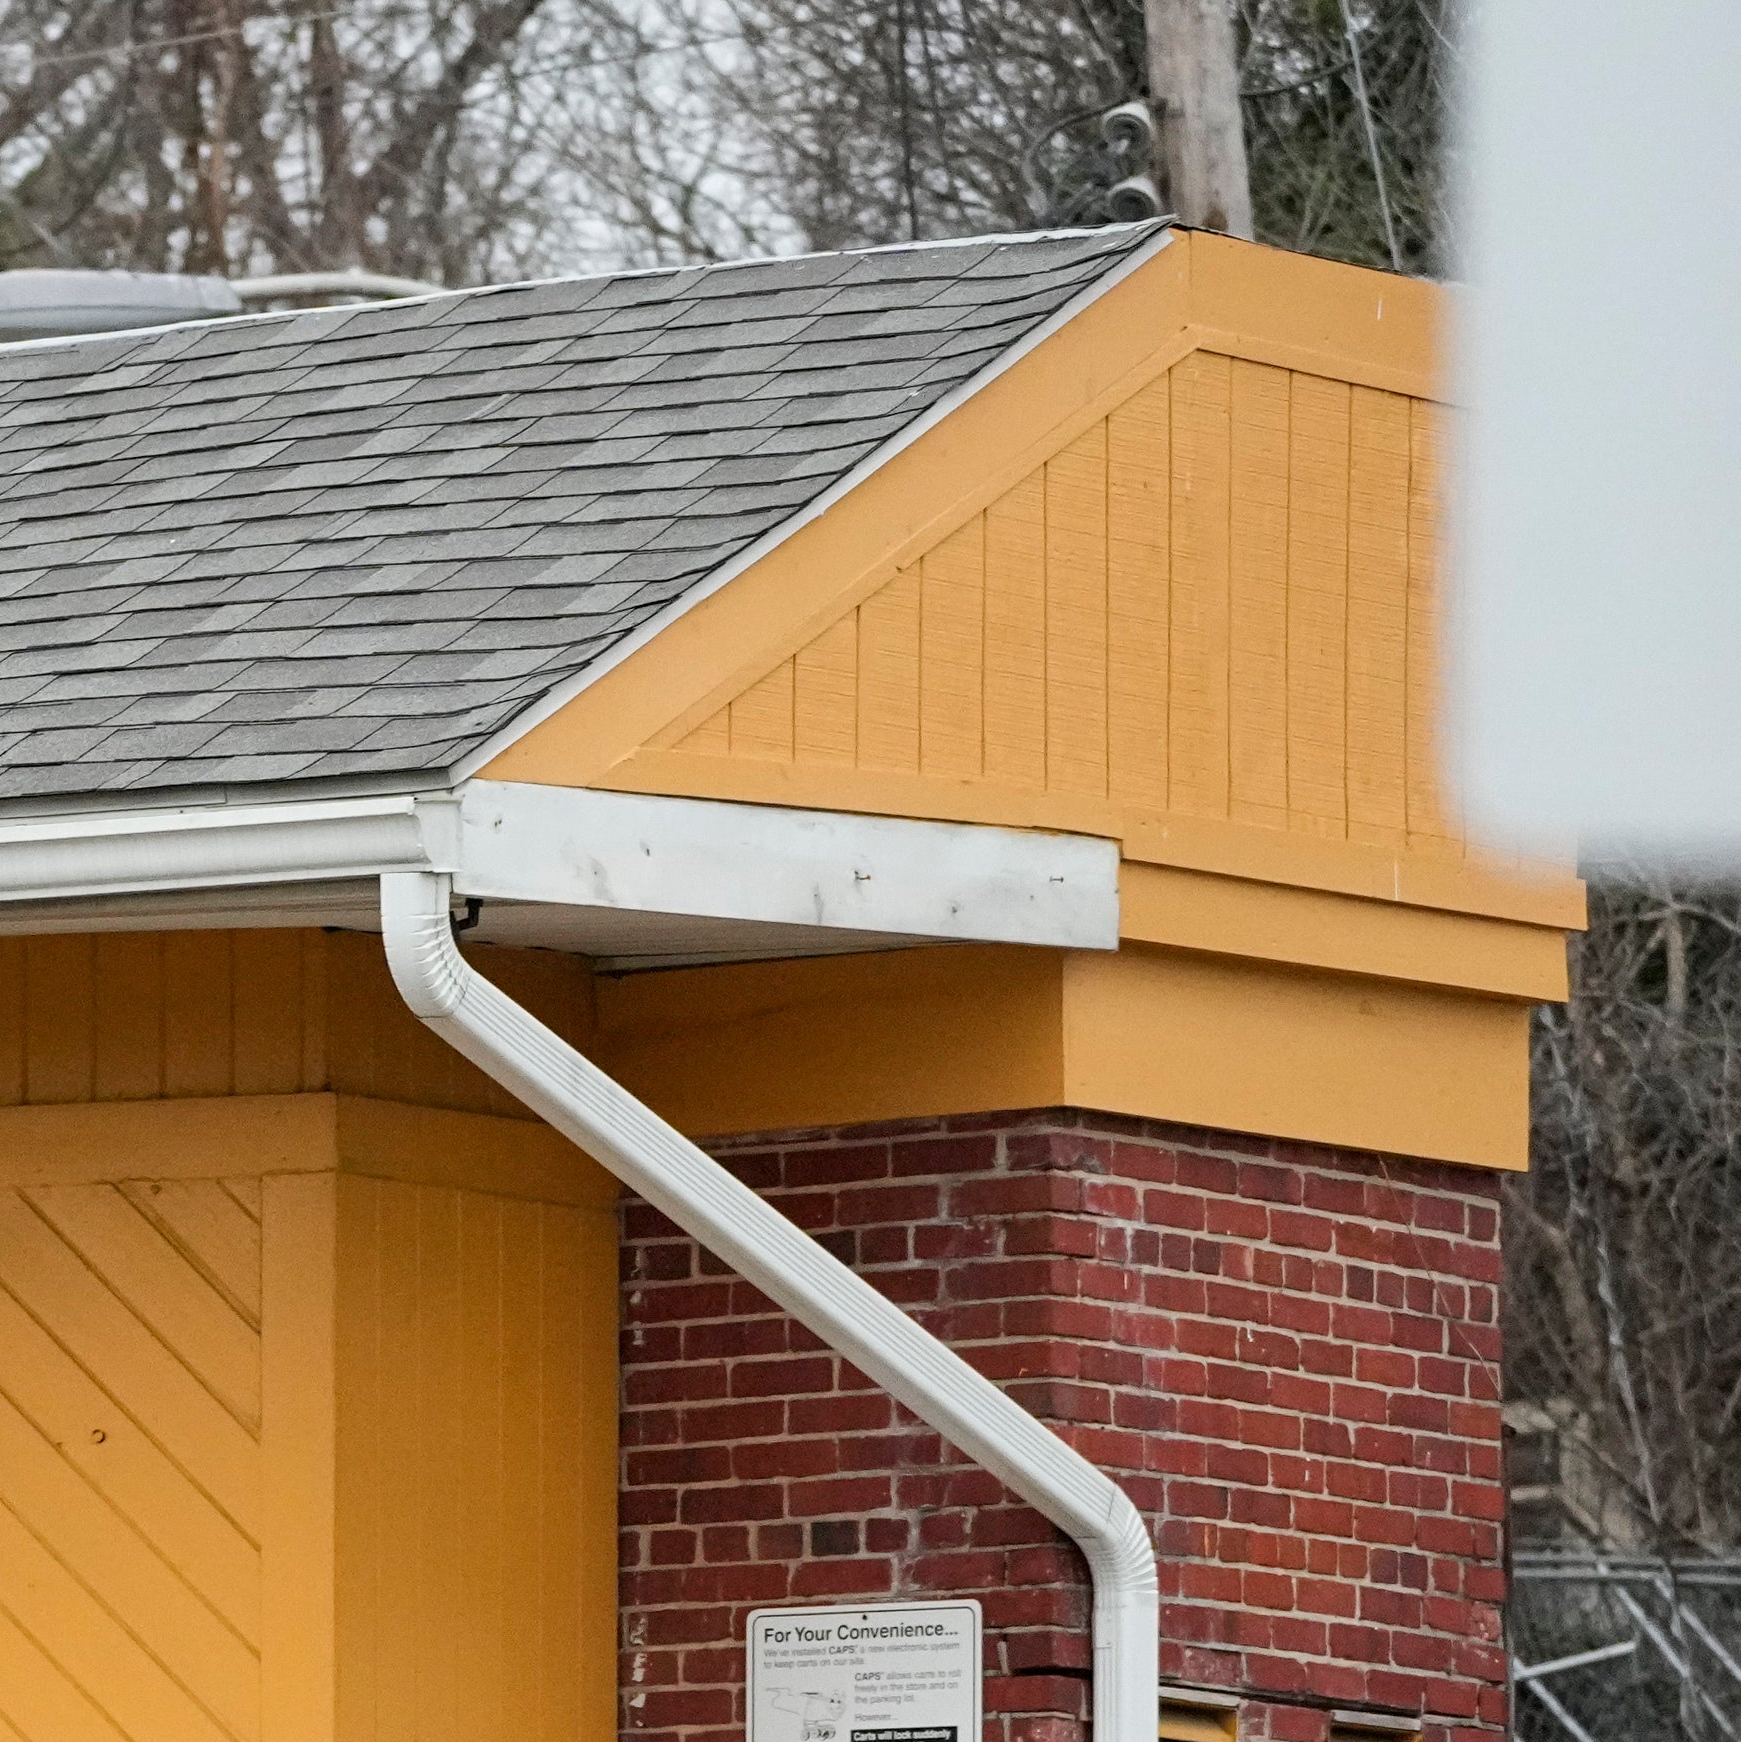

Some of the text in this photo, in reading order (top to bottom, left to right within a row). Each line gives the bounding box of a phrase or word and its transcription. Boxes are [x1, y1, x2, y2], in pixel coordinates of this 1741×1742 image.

[764, 1624, 958, 1644] For Your Convenience...
